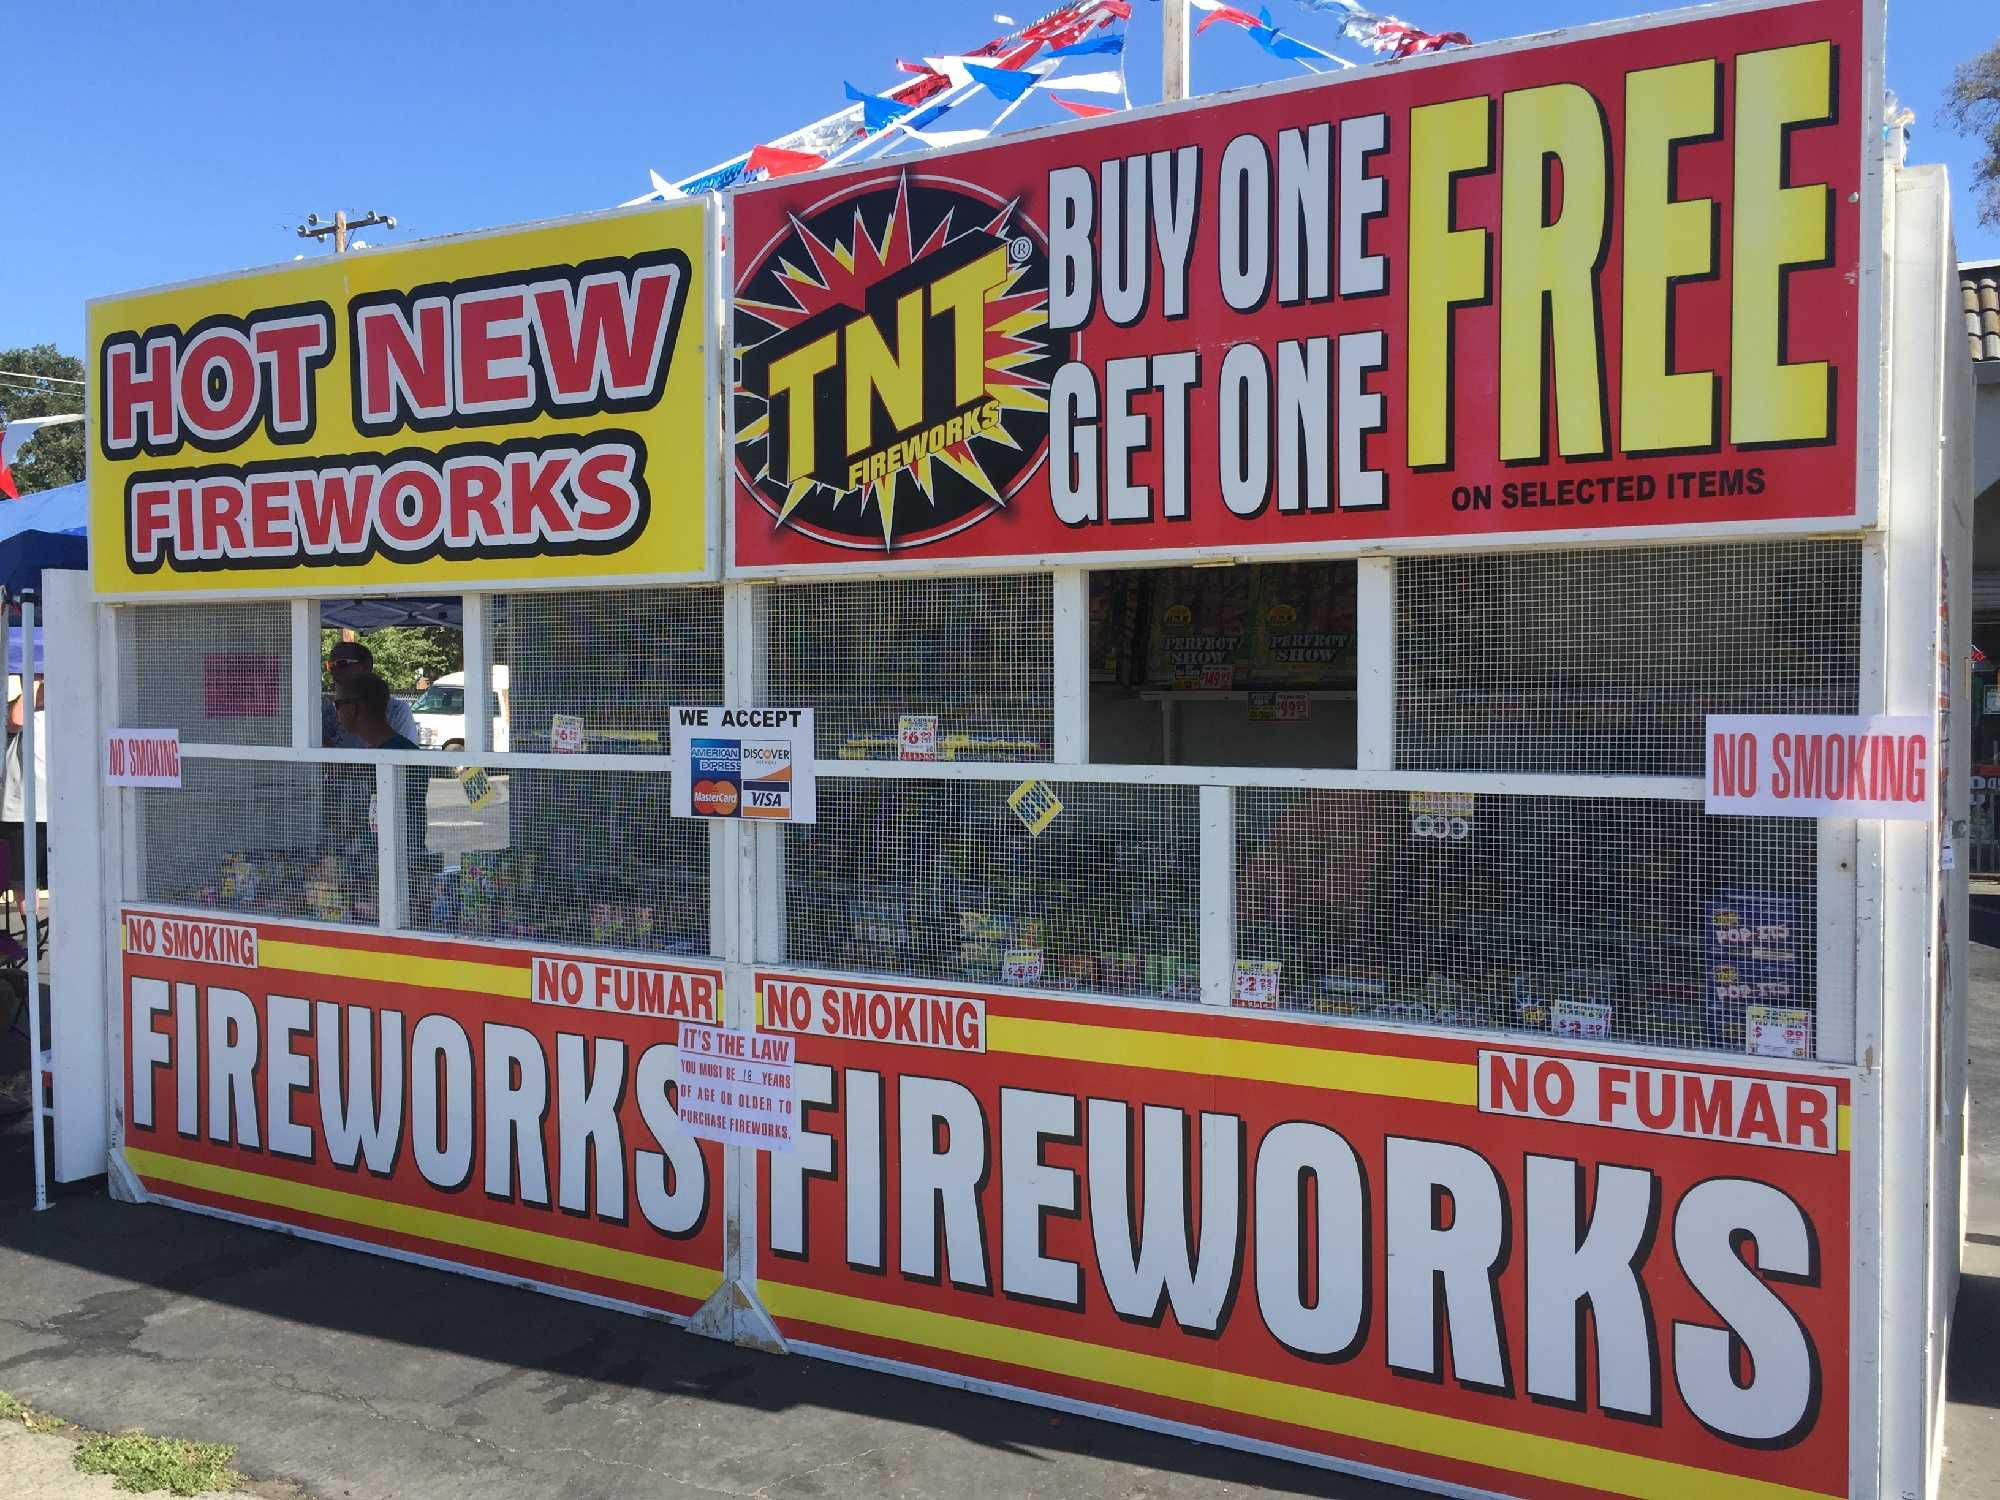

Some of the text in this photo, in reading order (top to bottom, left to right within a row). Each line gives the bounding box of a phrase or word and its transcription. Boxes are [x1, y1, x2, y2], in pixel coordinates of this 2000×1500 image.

[1049, 113, 1387, 330] BUY ONE
[1407, 41, 1835, 470] FREE
[105, 262, 681, 451] HOT NEW
[768, 243, 1008, 483] TNT
[848, 400, 1001, 490] FIREWORKS
[1049, 330, 1387, 526] GET ONE
[131, 443, 640, 562] FIREWORKS
[1451, 468, 1766, 511] ON SELECTED ITEMS
[679, 709, 802, 728] WE ACCEPT
[109, 738, 179, 777] NO SMOKING
[691, 748, 740, 760] AMERICAN
[701, 760, 742, 771] EXPRESS
[743, 748, 790, 760] DISCOVER
[1713, 732, 1927, 803] NO SMOKING
[694, 791, 737, 804] MasterCard
[752, 792, 782, 807] VISA
[128, 917, 255, 967] NO SMOKING
[536, 960, 714, 1023] NO FUMAR
[766, 984, 981, 1050] NO SMOKING
[683, 1028, 789, 1061] IT'S THE LAW
[681, 1059, 696, 1074] YOU
[700, 1063, 722, 1078] MUST
[726, 1066, 735, 1081] BE
[762, 1072, 791, 1089] YEARS
[681, 1084, 791, 1114] OF AGE OR OLDER TO
[131, 974, 709, 1240] FIREWORKS
[681, 1109, 791, 1140] PURCHASE FIREWORKS.
[1490, 1055, 1830, 1150] NO FUMAR
[768, 1063, 1822, 1450] FIREWORKS
